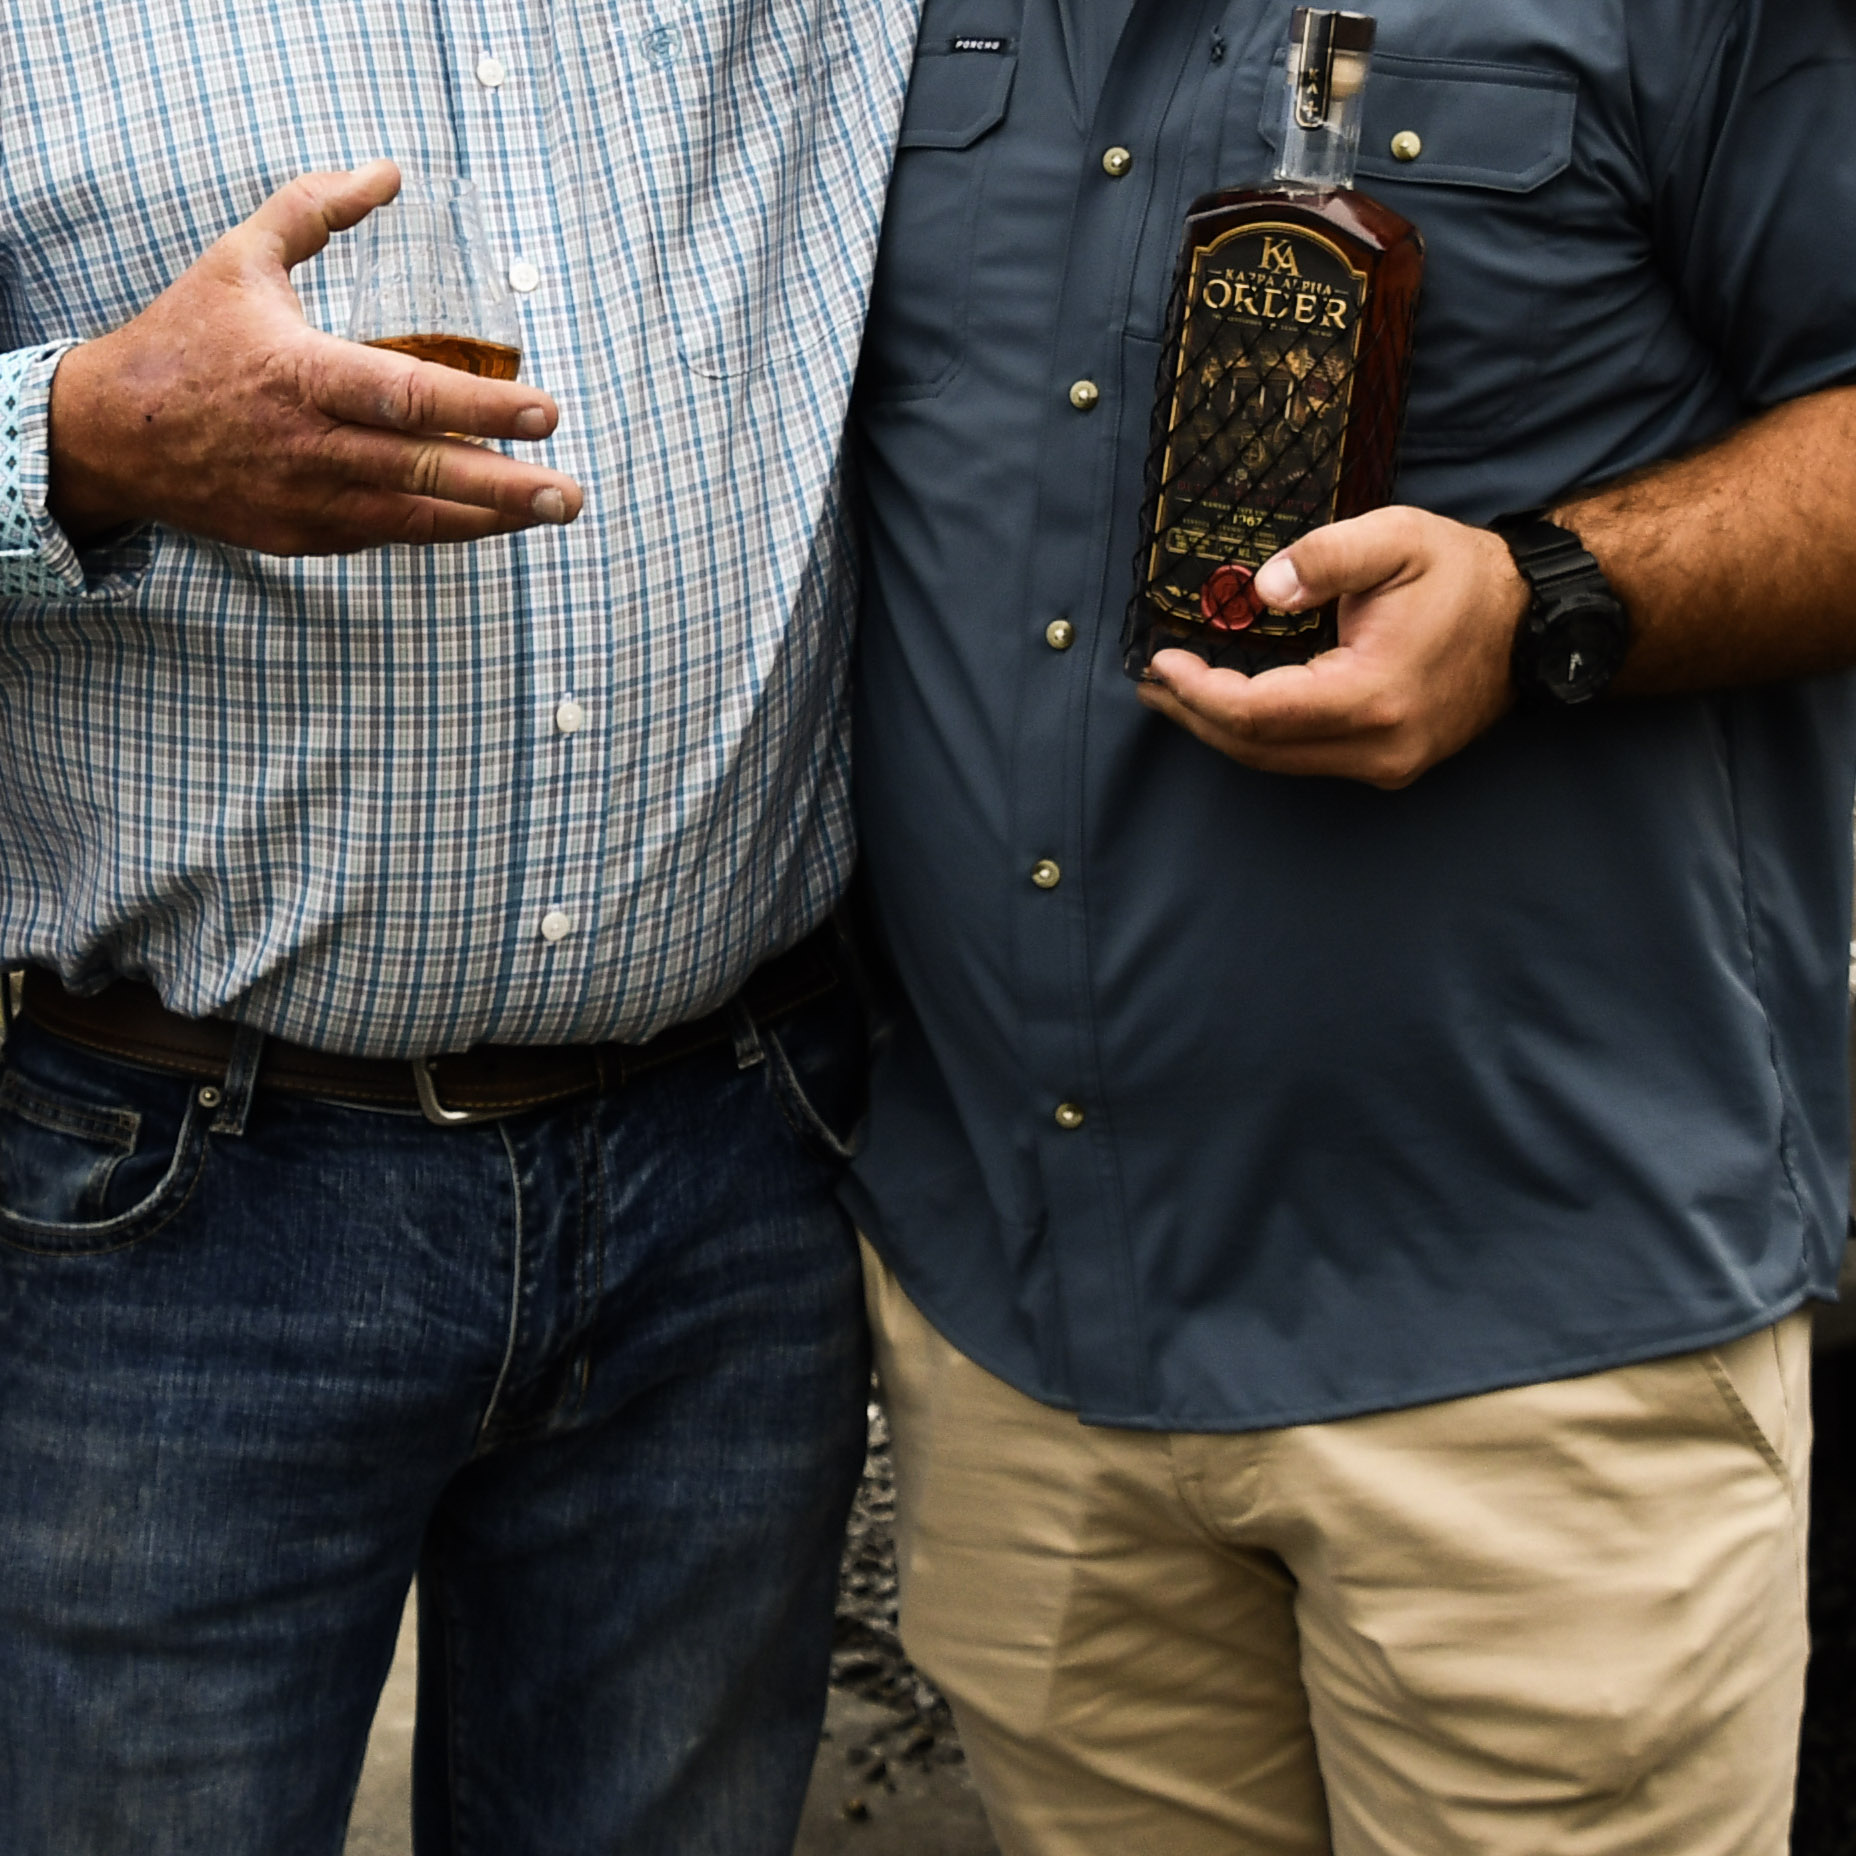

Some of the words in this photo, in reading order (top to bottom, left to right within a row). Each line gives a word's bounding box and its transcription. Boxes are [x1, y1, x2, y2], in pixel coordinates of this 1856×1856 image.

[1257, 236, 1303, 277] KA
[1225, 268, 1275, 287] KAPPA
[1281, 277, 1332, 295] ALPHA
[1202, 278, 1347, 330] ORDER
